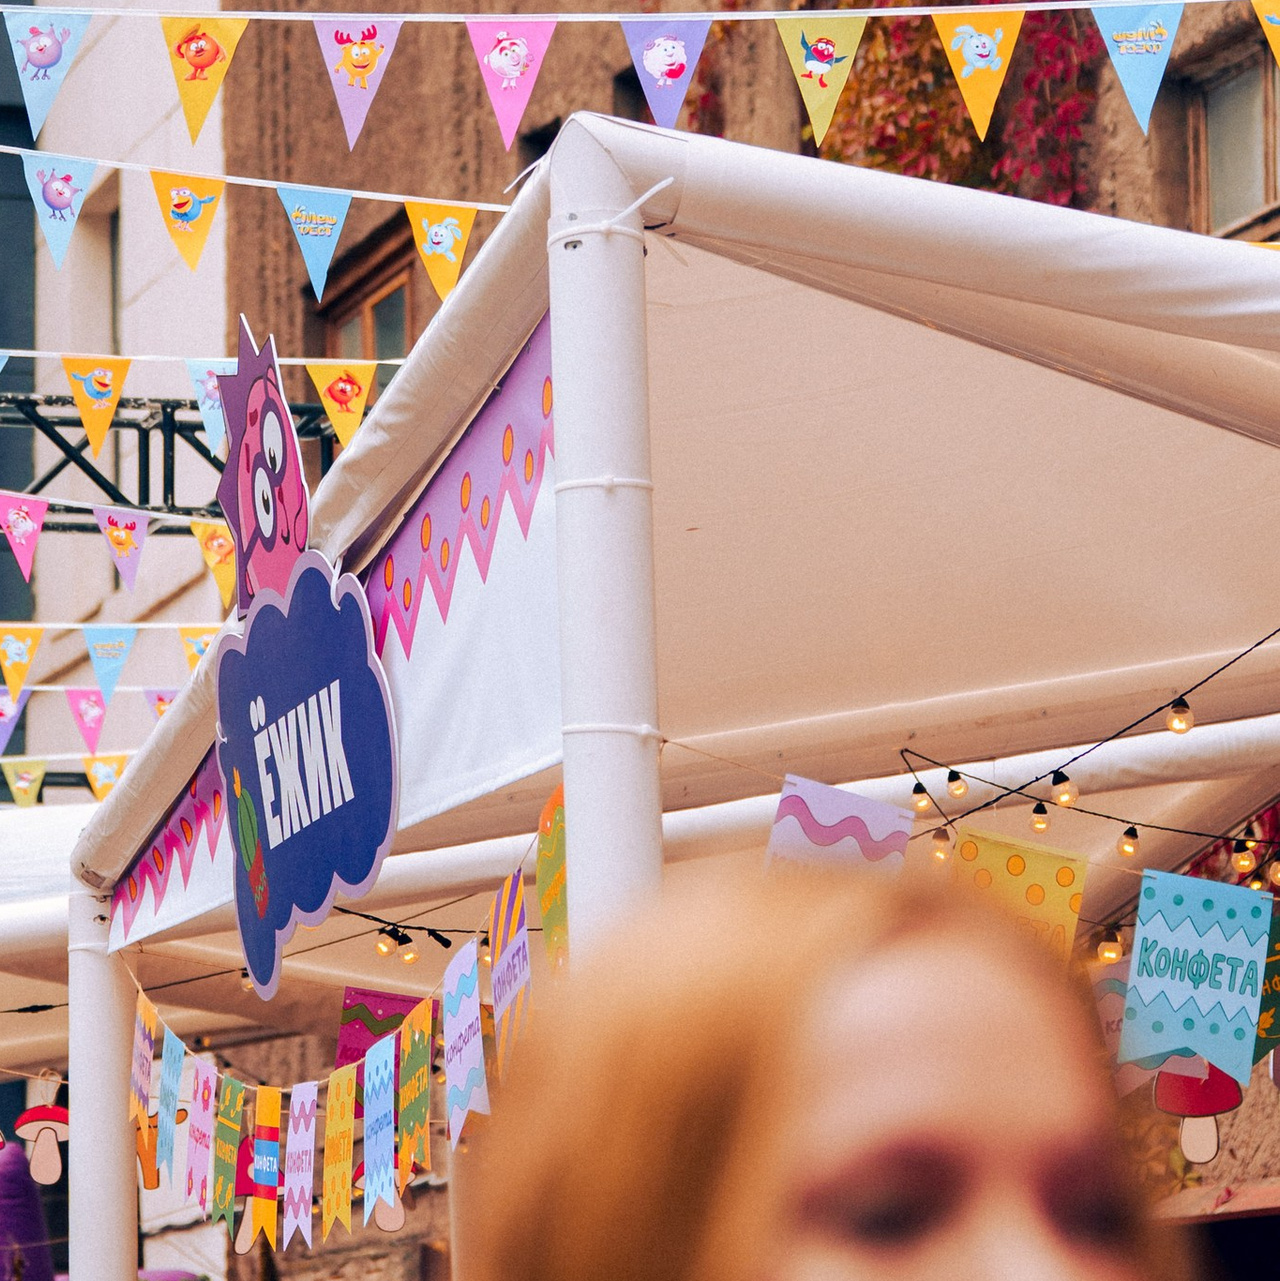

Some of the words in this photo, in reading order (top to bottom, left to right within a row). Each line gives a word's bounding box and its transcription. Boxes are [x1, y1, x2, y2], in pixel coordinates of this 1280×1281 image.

[250, 679, 354, 849] ЁЖИК
[493, 939, 529, 1008] КОНФЕТА
[1137, 937, 1258, 998] КОНФЕТА
